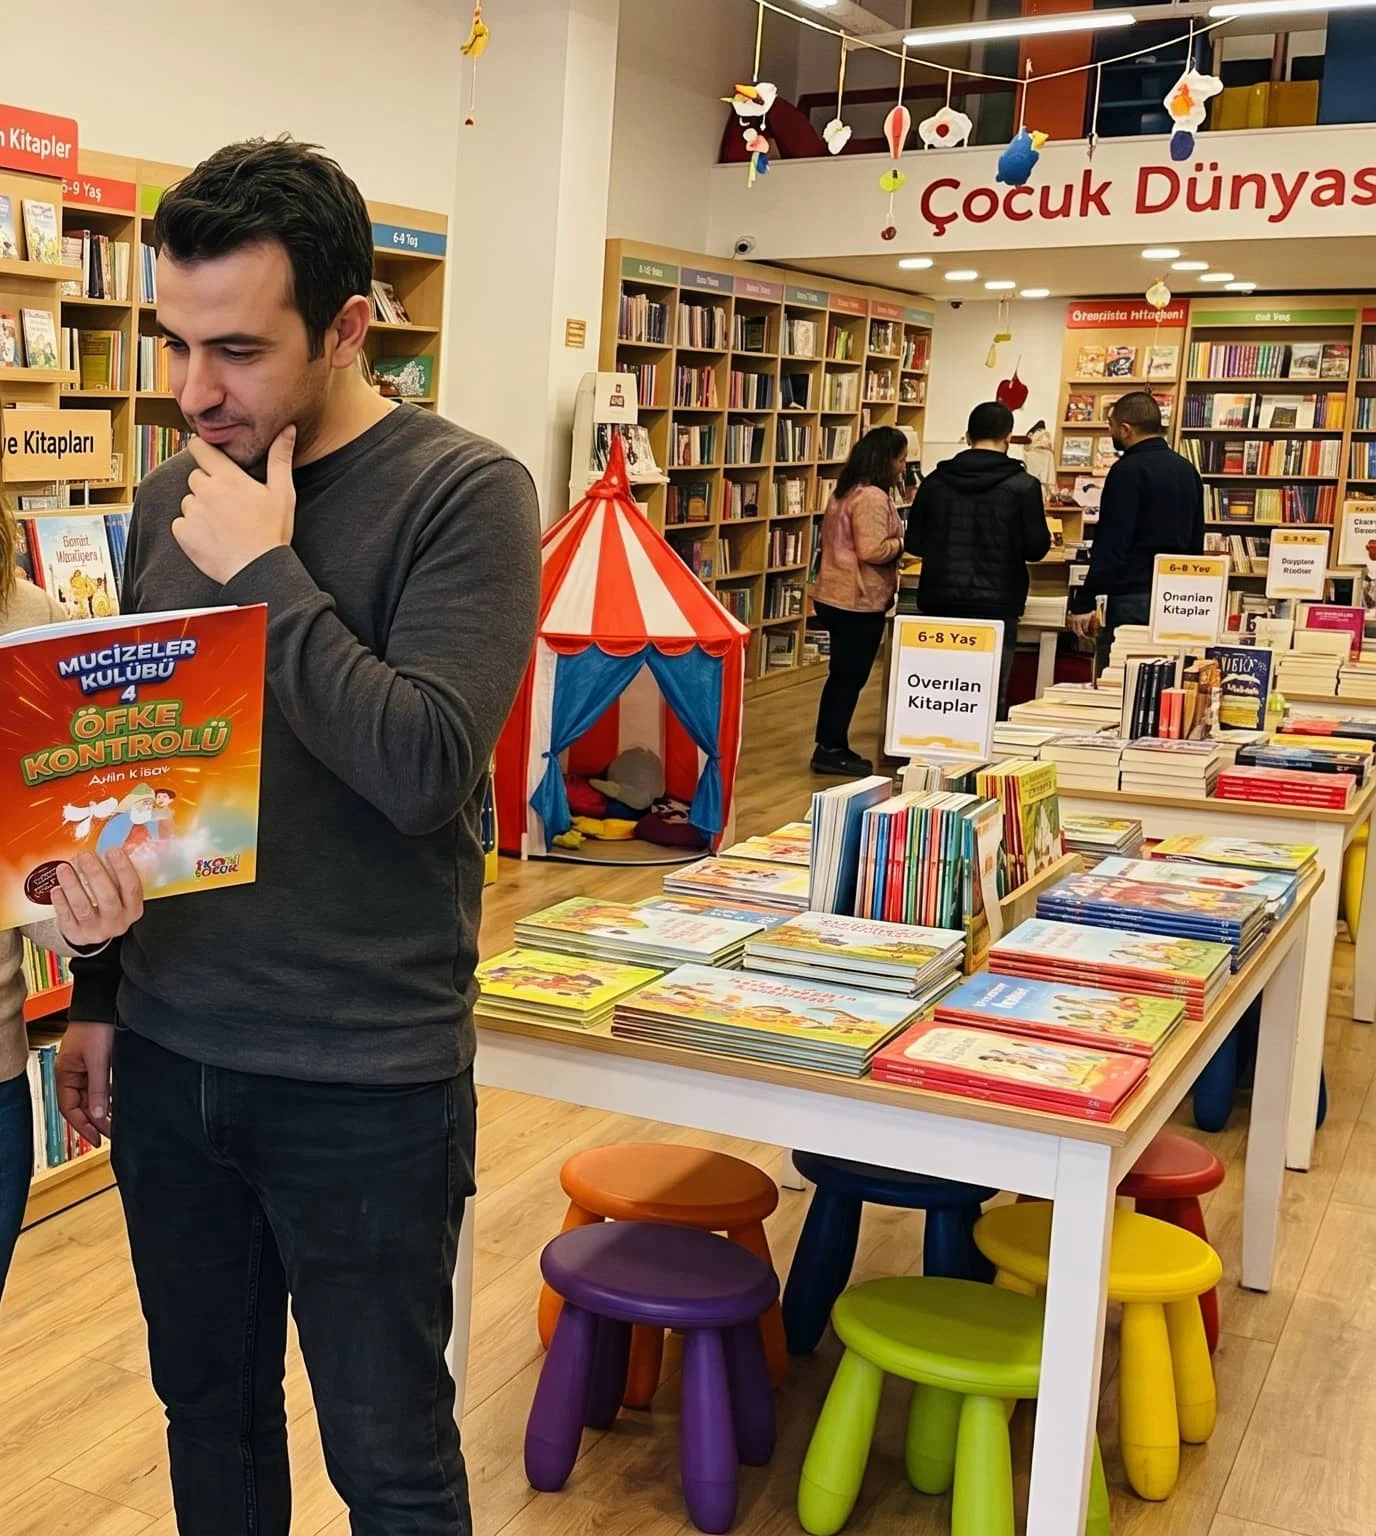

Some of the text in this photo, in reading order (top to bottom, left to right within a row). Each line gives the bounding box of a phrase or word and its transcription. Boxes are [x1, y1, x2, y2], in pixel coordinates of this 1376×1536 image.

[83, 182, 102, 203] Yaş
[920, 168, 1113, 236] Çocuk
[24, 429, 94, 460] Kitapları
[918, 631, 978, 647] 6-8 Yaş
[59, 638, 197, 676] MUCİZELER
[80, 658, 175, 691] KULÜBÜ
[121, 685, 137, 702] 4
[908, 695, 978, 714] Kitaplar
[74, 703, 179, 739] ÖFKE
[24, 720, 228, 781] KONTROLÜ
